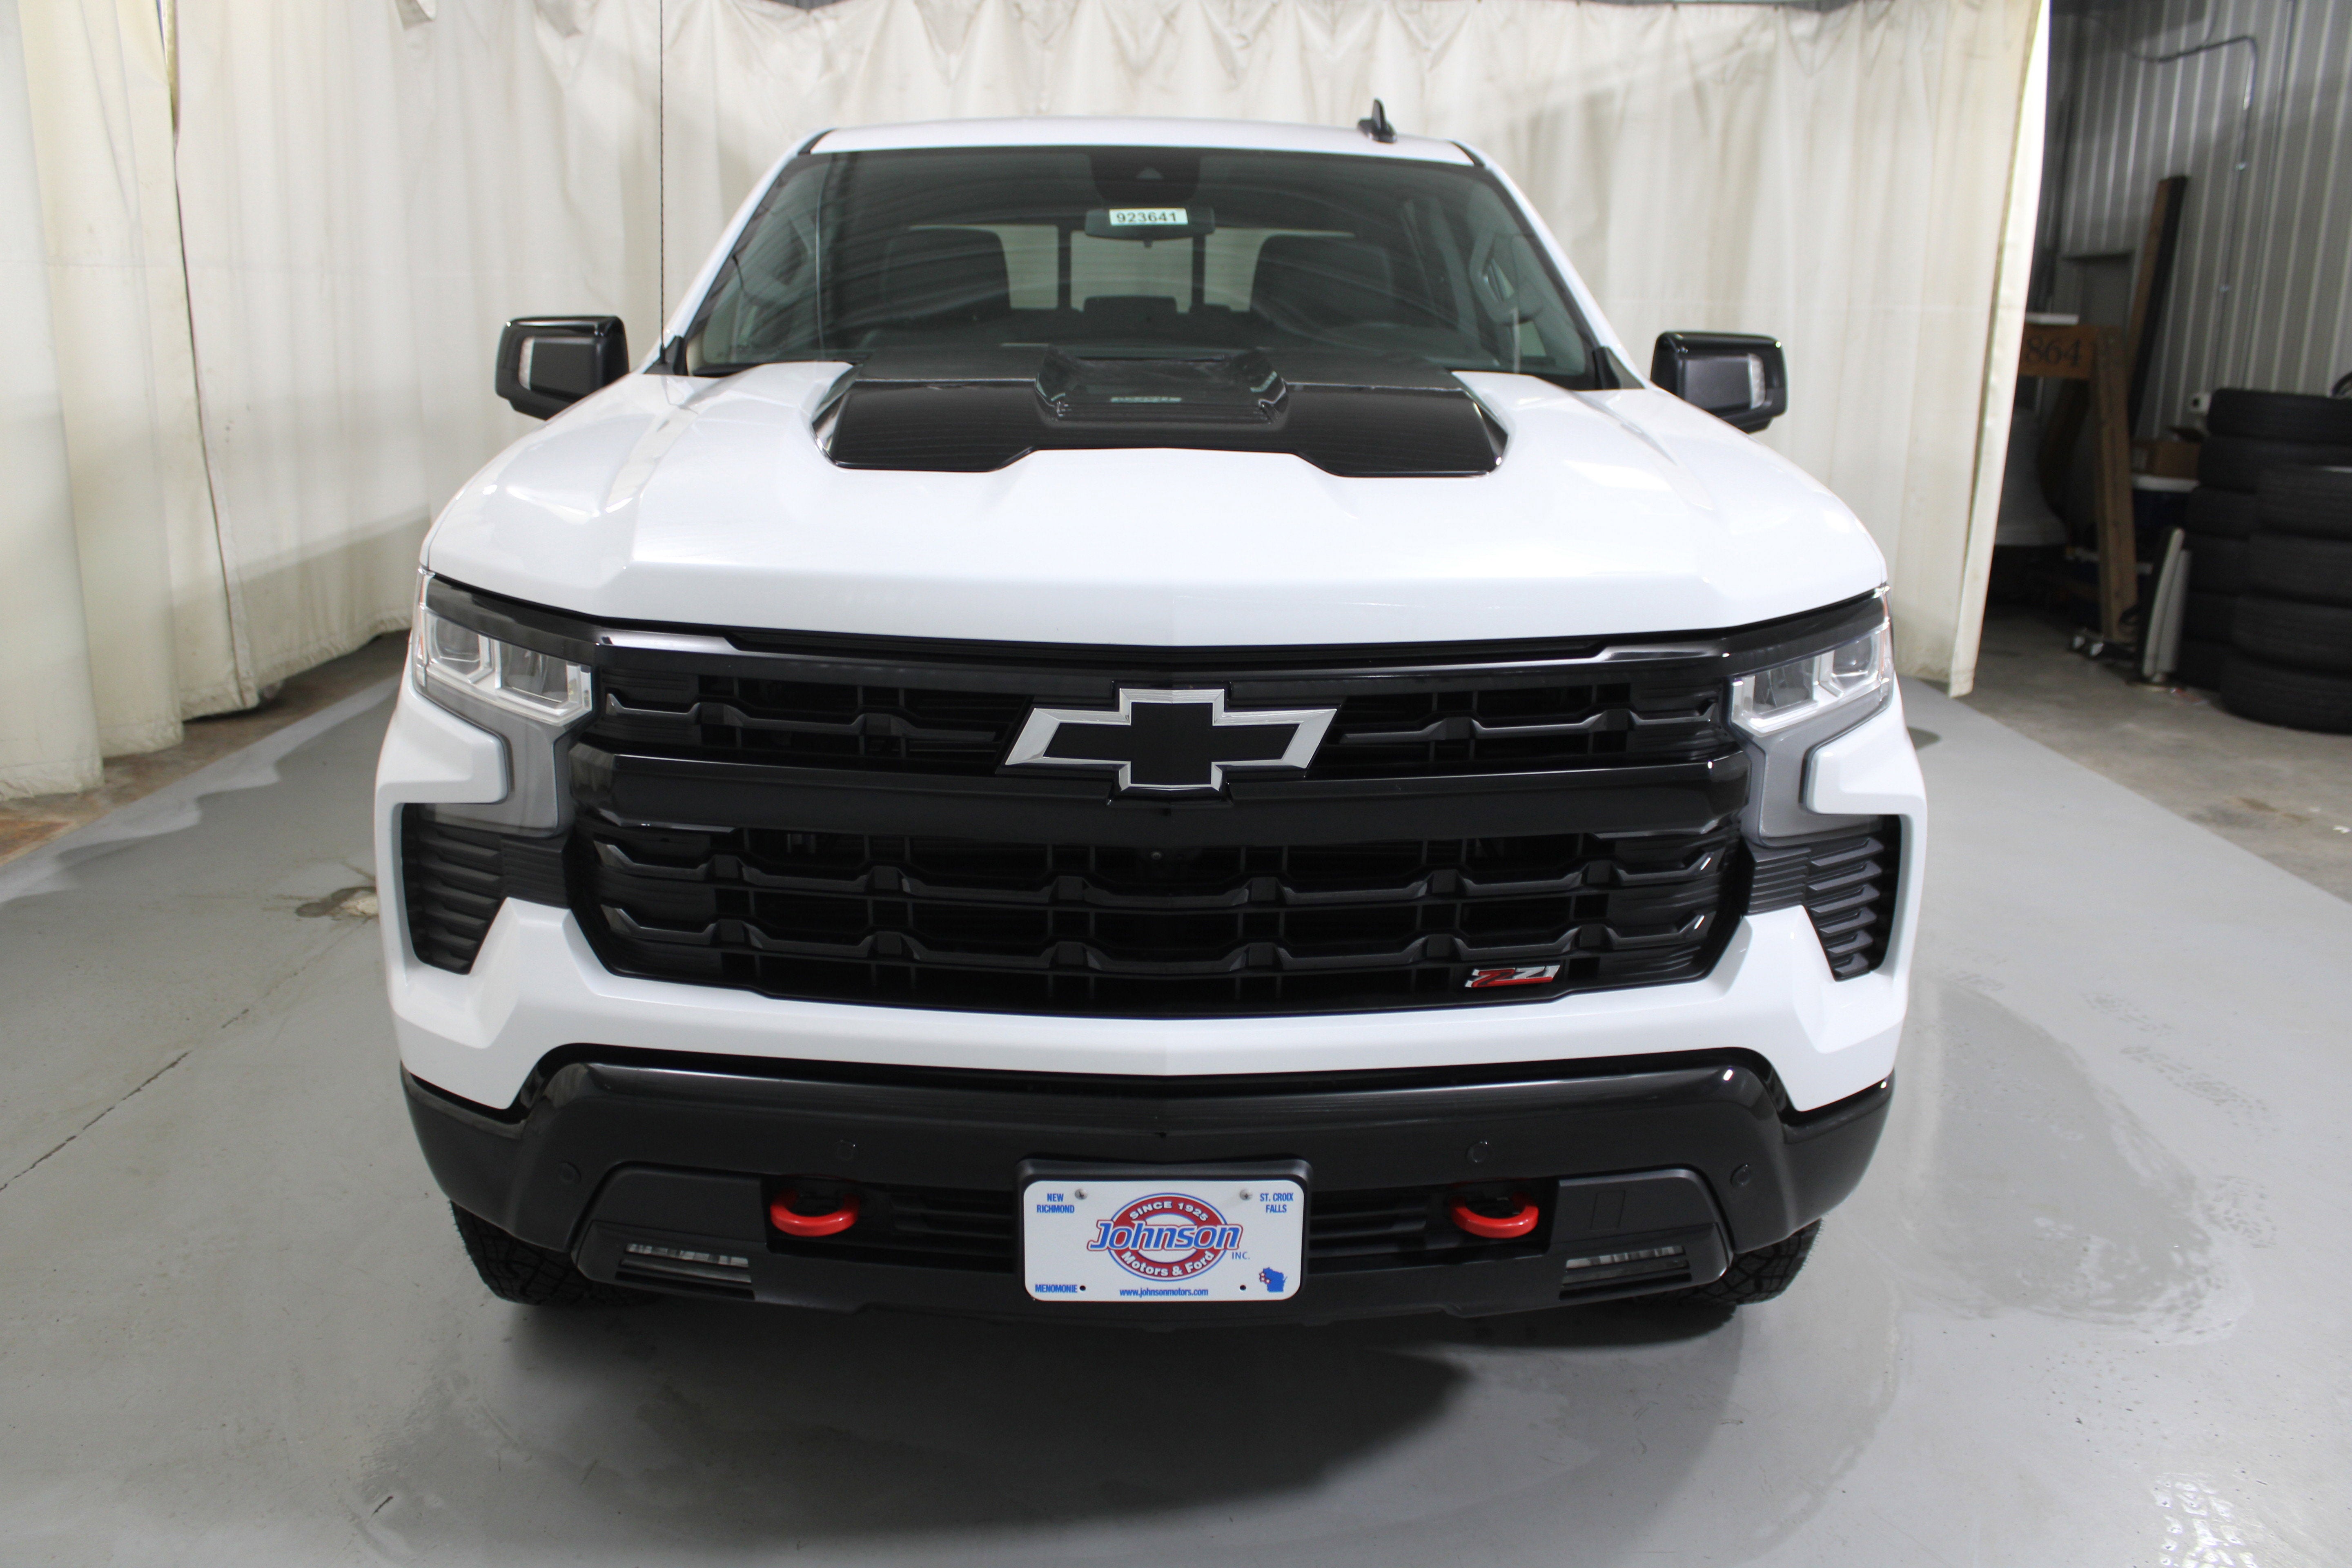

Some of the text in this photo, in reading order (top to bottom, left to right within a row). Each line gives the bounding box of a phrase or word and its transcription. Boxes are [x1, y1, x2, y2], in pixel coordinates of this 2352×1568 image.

[1117, 212, 1176, 223] 923641
[1465, 965, 1560, 987] Z71
[1260, 1193, 1294, 1201] ST. CROIX
[1036, 1205, 1075, 1213] RICHMOND
[1129, 1201, 1209, 1221] SINCE 1925
[1266, 1204, 1287, 1213] FALLS
[1089, 1221, 1241, 1250] Johnson
[1232, 1252, 1250, 1260] INC.
[1121, 1251, 1214, 1276] Motors & Ford
[1035, 1285, 1078, 1293] MENOMONIE
[1120, 1287, 1209, 1298] www.johnsonmotors.com
